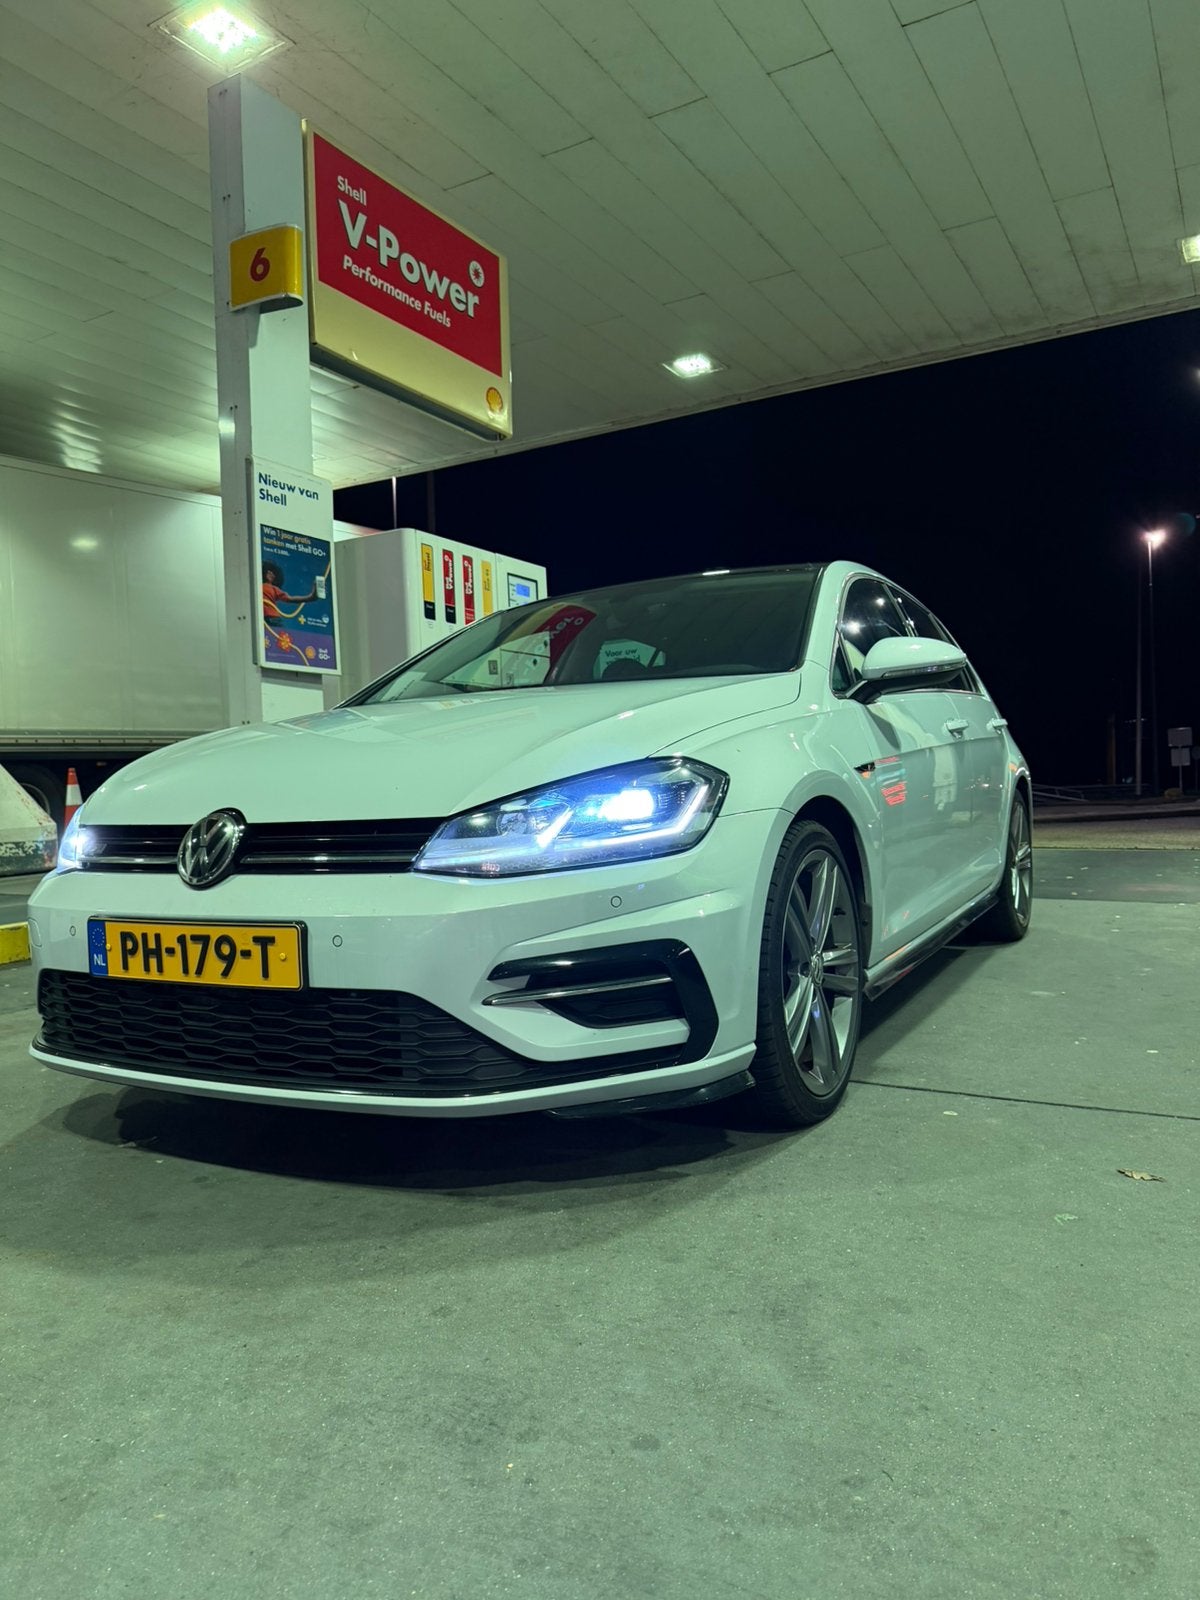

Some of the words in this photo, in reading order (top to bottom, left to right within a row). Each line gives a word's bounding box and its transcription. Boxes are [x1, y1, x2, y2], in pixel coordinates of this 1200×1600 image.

[337, 175, 367, 206] Shell
[249, 247, 271, 282] 6
[338, 198, 480, 318] V-Power
[343, 254, 422, 312] Performance
[424, 301, 452, 328] Fuels
[258, 471, 296, 494] Nieuw
[298, 486, 319, 501] van
[259, 488, 287, 506] Shell
[263, 526, 276, 536] Win
[285, 542, 297, 551] met
[298, 543, 312, 554] Shell
[93, 953, 106, 967] NL
[119, 930, 276, 980] PH-179-T
